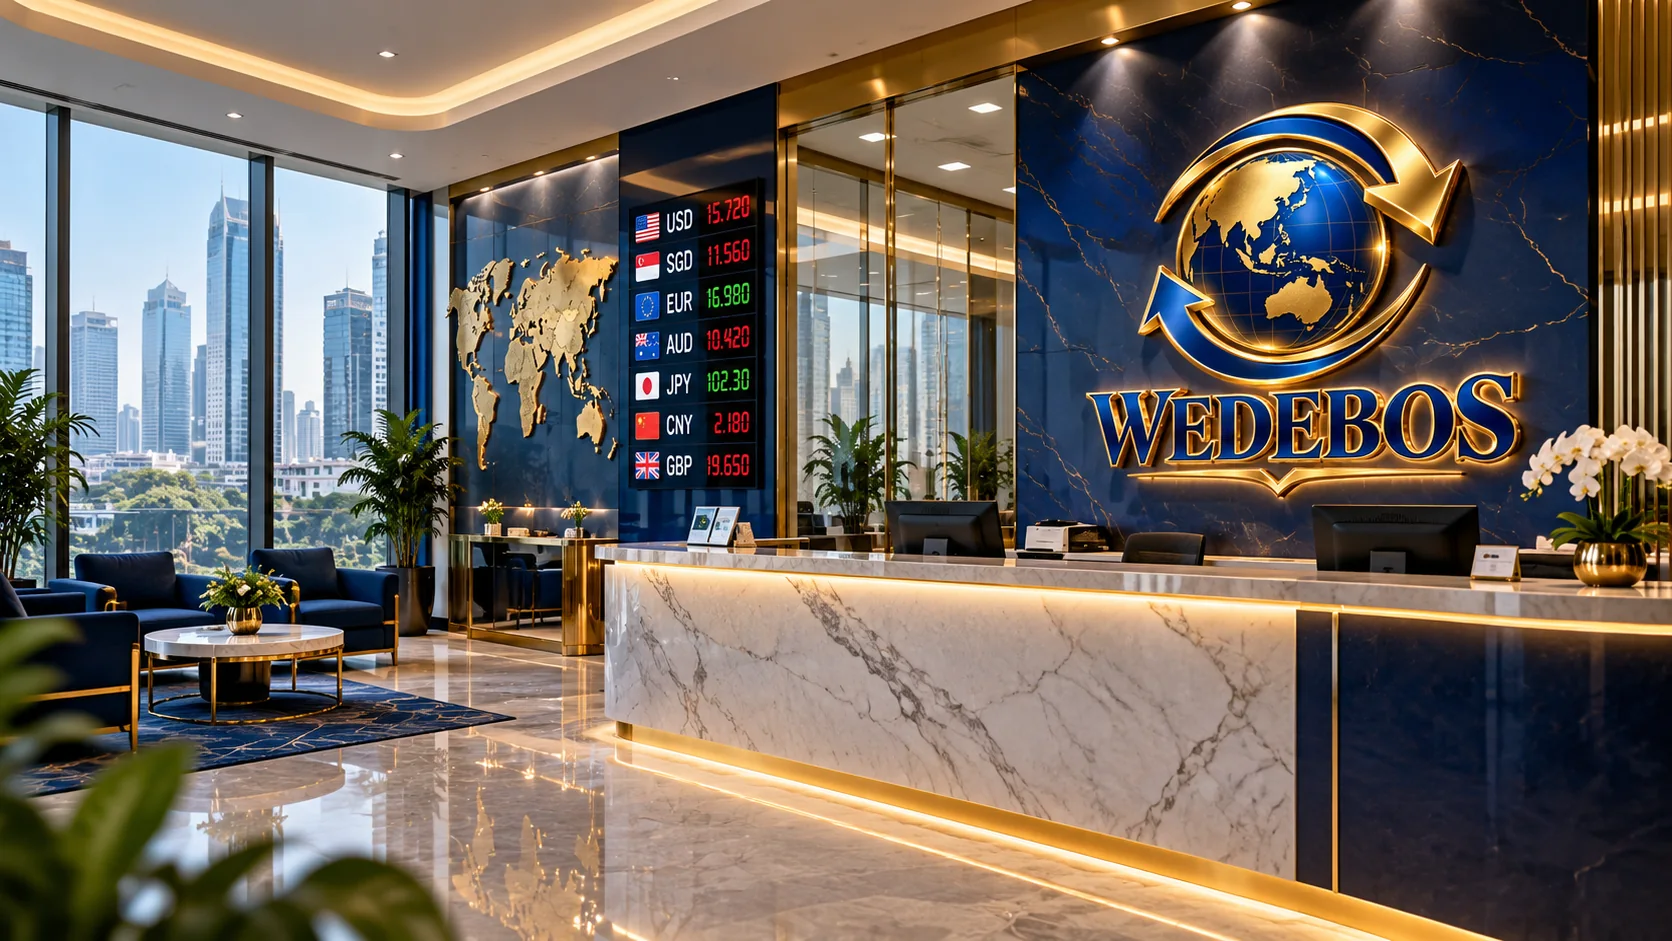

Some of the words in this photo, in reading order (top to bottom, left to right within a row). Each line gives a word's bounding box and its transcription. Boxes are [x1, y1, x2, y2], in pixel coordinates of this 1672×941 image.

[666, 209, 693, 233] USD
[707, 195, 750, 225] 15.720
[666, 250, 693, 274] SGD
[708, 239, 750, 266] 11.560
[666, 291, 693, 314] EUR
[707, 282, 750, 309] 16.980
[666, 332, 693, 355] AUD
[706, 325, 750, 351] 10.420
[666, 373, 692, 395] JPY
[707, 368, 750, 393] 102.30
[666, 414, 693, 436] CNY
[714, 411, 750, 434] 2.180
[1086, 371, 1522, 468] WEDEBOS
[666, 455, 693, 477] GBP
[707, 454, 750, 477] 19.650
